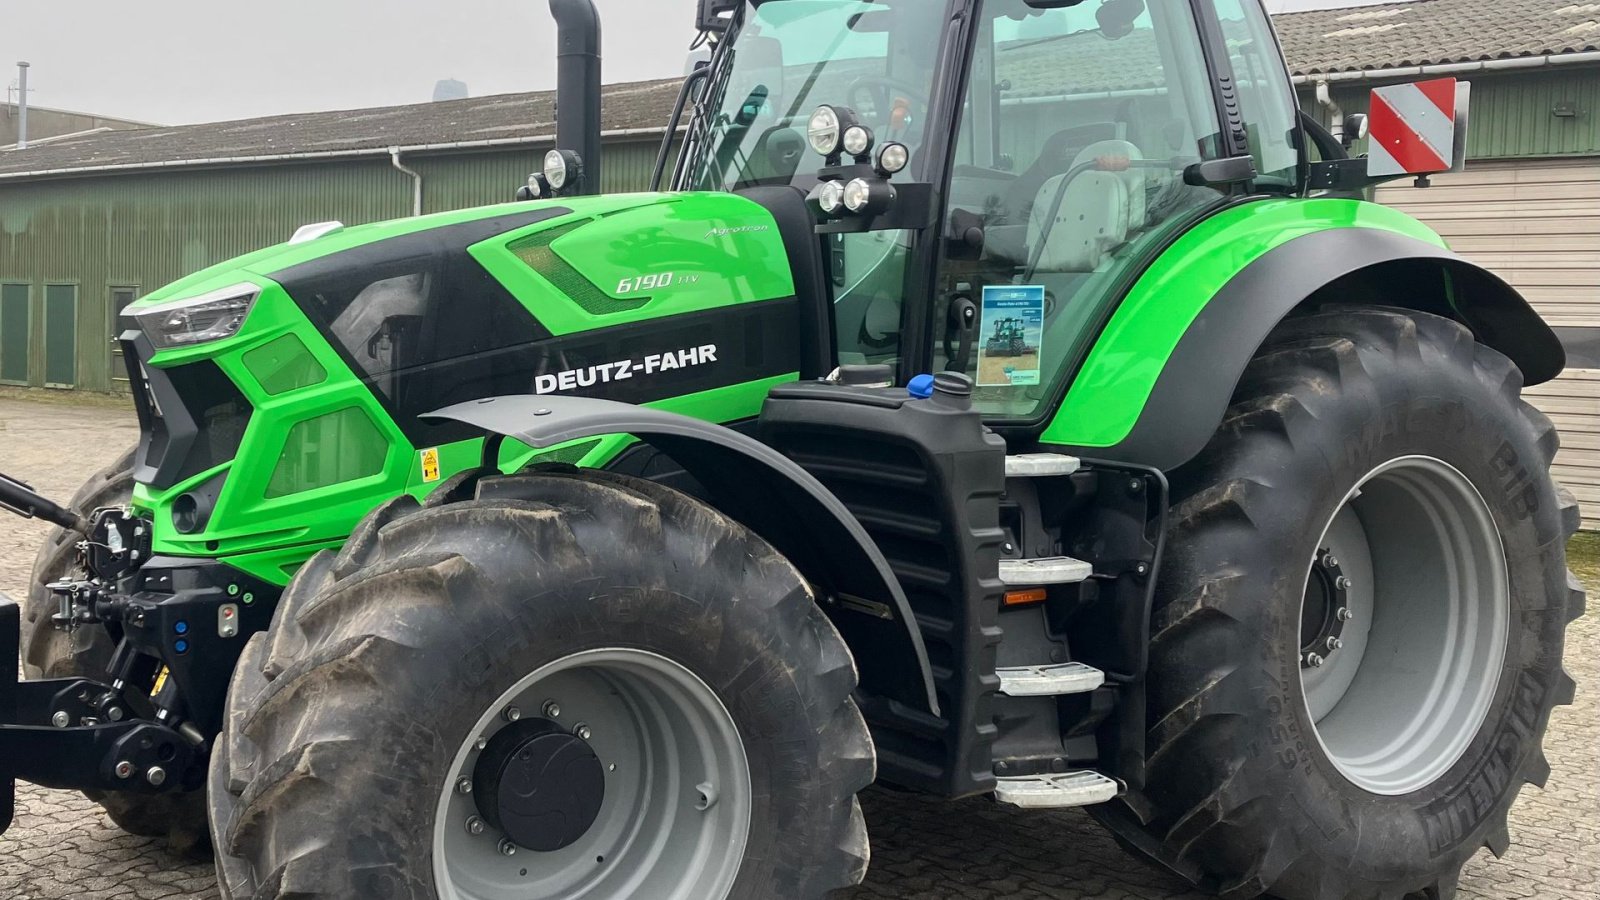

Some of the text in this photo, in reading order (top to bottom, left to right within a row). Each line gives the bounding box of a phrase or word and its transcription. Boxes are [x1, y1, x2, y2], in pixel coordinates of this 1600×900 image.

[704, 224, 768, 239] Agrotron
[616, 272, 674, 294] 6190
[535, 344, 717, 394] DEUTZ-FAHR
[1427, 672, 1546, 857] MICHELIN
